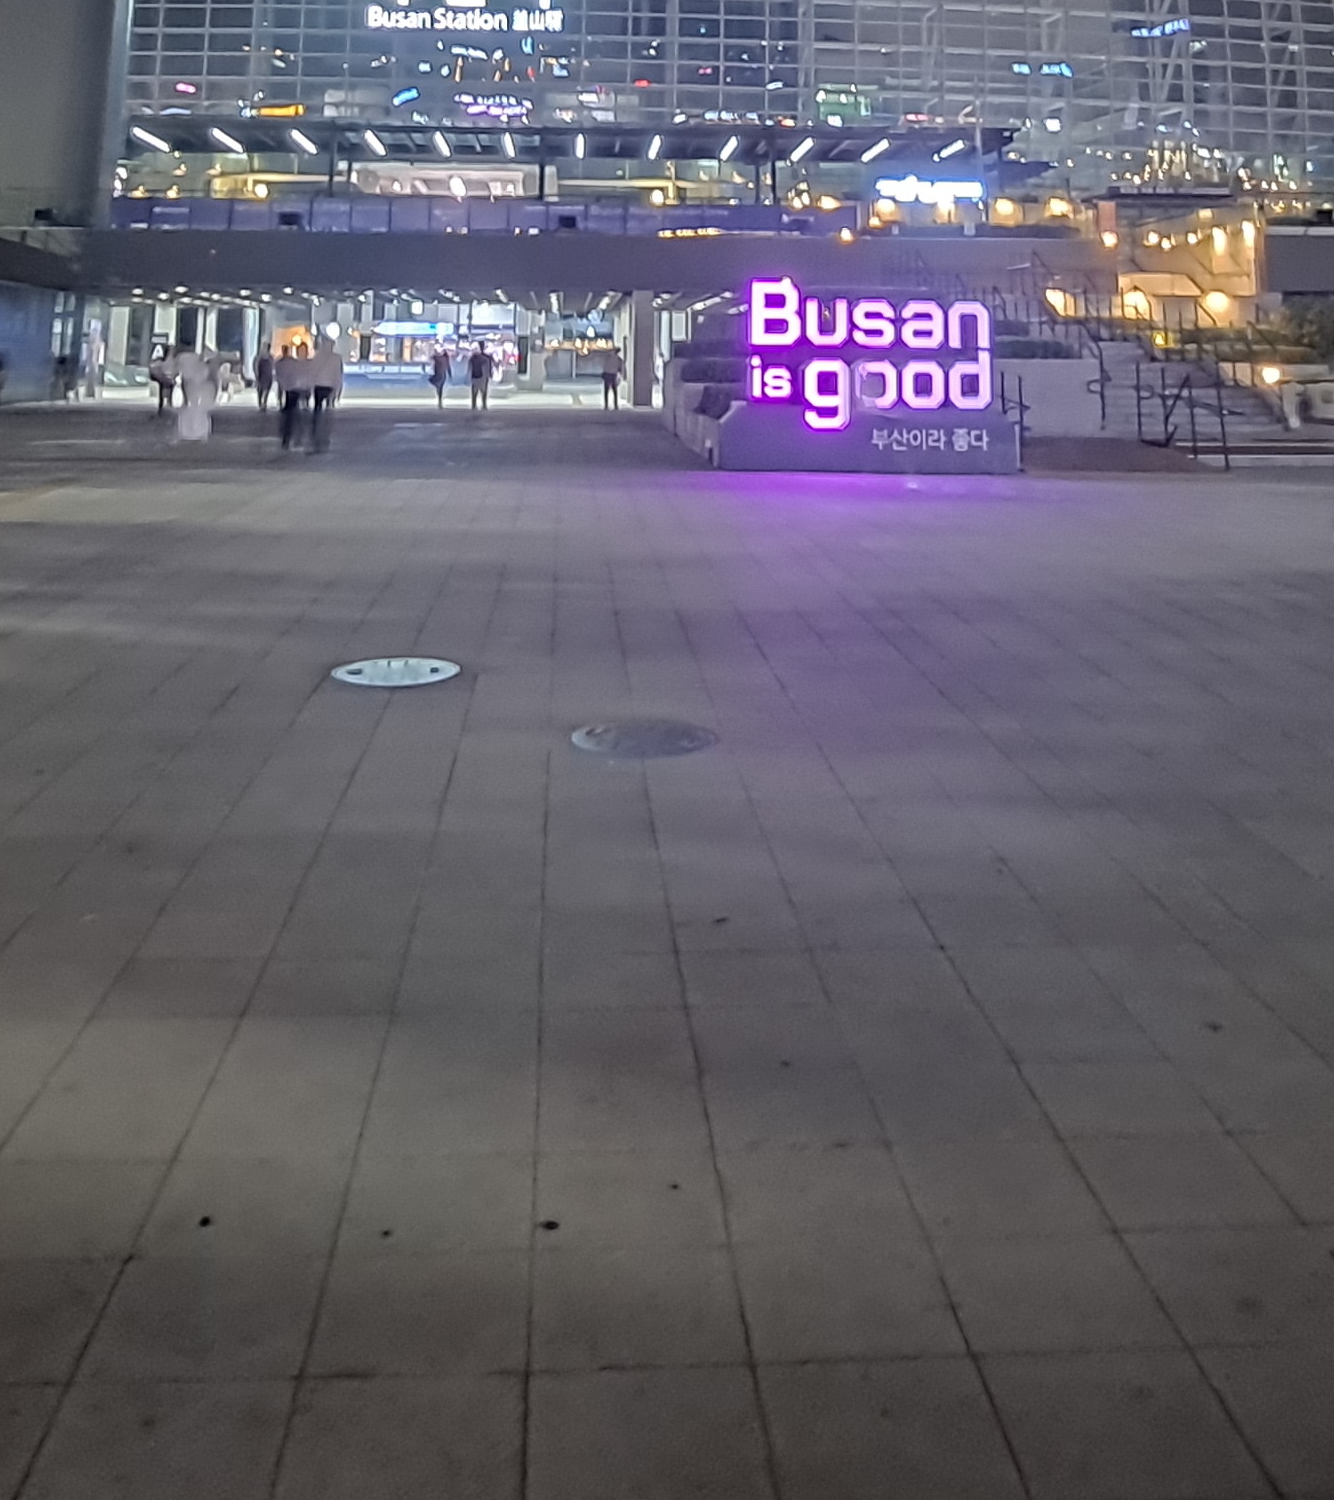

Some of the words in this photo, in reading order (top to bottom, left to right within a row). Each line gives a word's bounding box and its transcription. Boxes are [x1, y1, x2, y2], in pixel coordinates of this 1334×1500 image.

[367, 5, 432, 29] Busan
[433, 7, 508, 31] Station
[749, 276, 992, 348] Busan
[750, 355, 792, 398] is
[803, 348, 992, 430] good
[872, 428, 947, 451] 부산이라
[952, 428, 990, 452] 좋다
